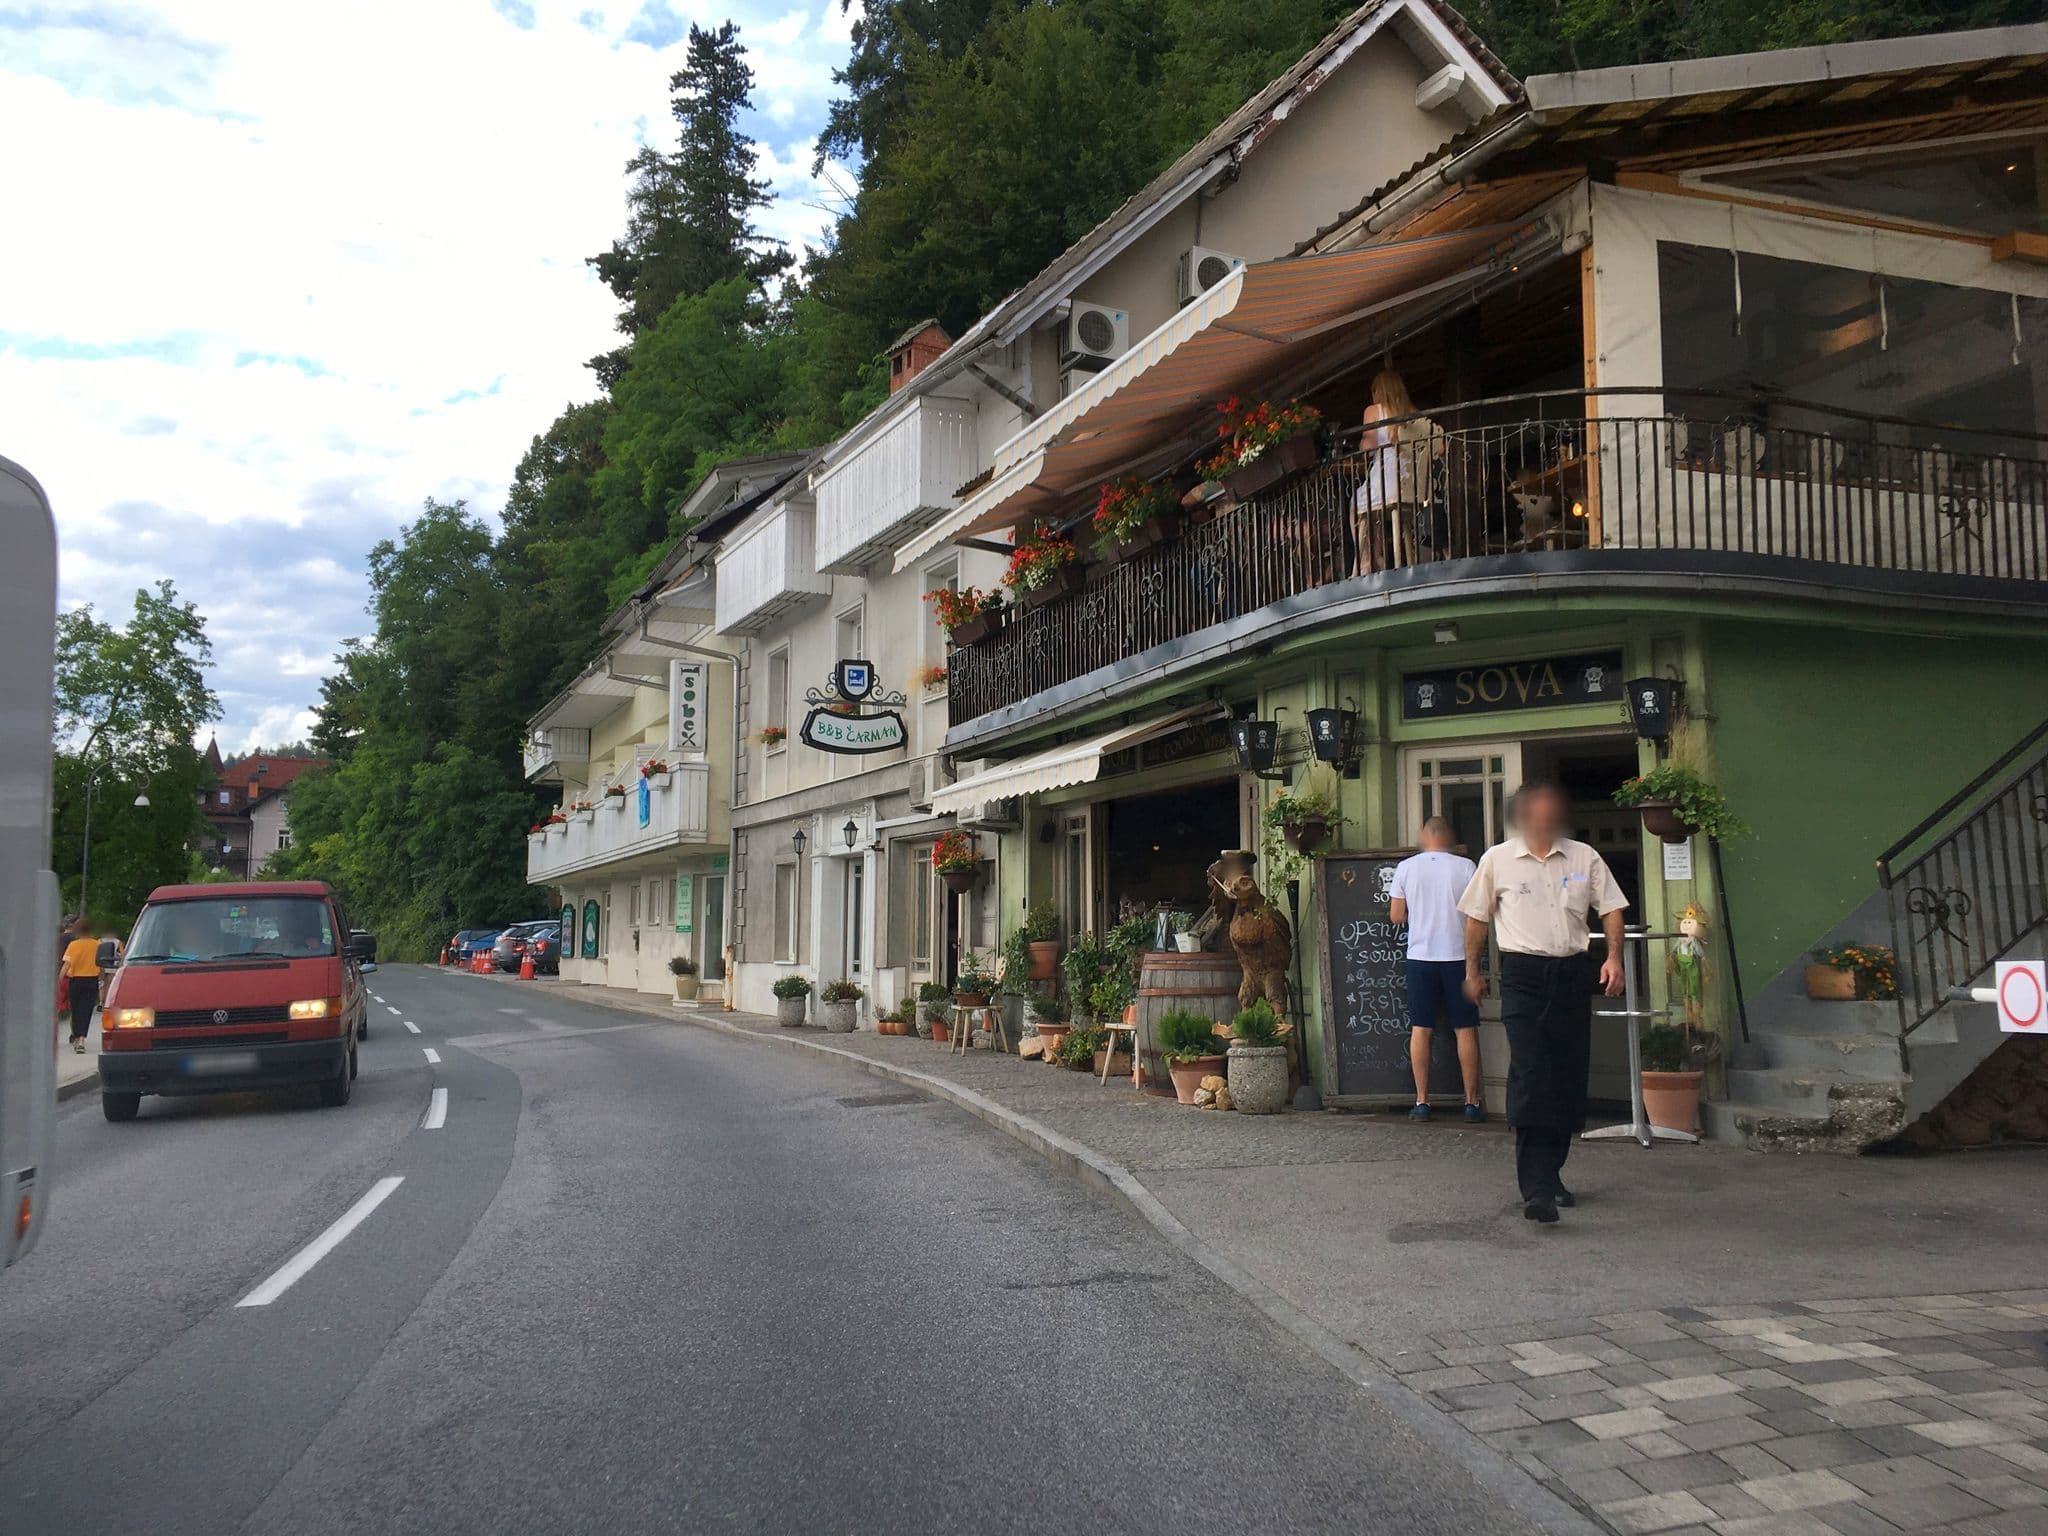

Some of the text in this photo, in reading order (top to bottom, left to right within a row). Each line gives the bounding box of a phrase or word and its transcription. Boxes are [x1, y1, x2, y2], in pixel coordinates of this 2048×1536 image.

[1456, 662, 1564, 705] SOVA
[817, 721, 898, 744] B&B ČARMAN
[1373, 892, 1390, 903] SO
